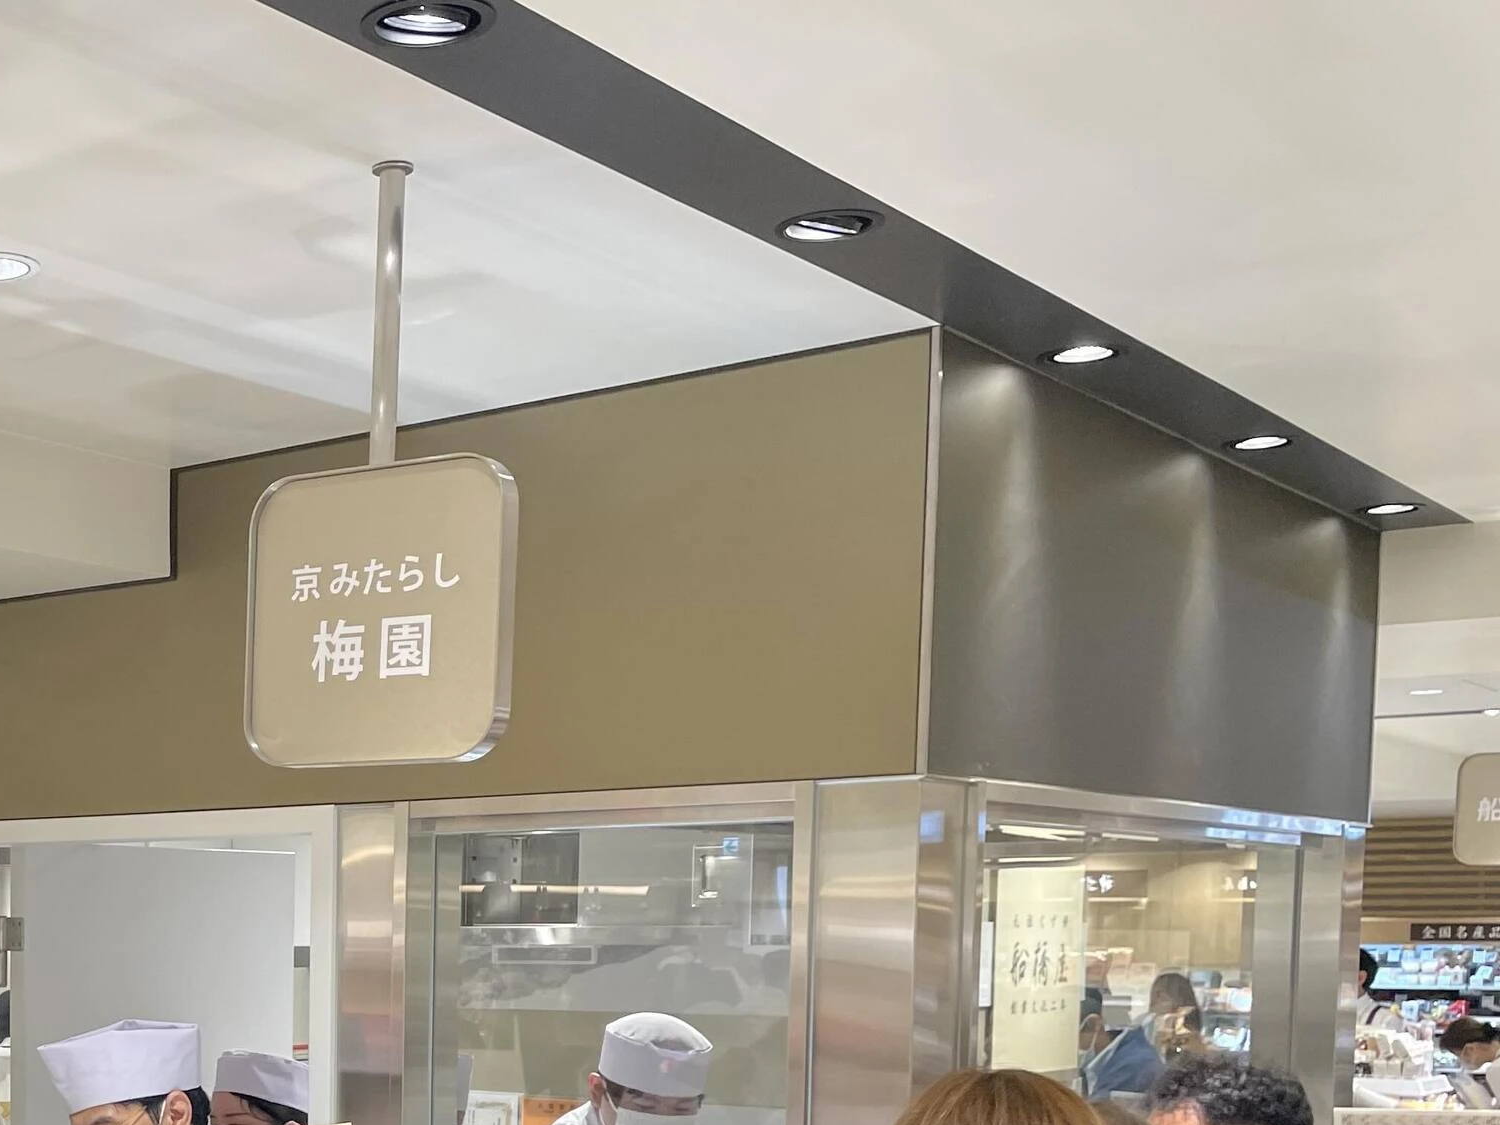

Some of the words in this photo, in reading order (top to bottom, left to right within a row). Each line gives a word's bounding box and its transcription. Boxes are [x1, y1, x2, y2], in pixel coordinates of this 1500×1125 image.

[291, 552, 461, 602] 京みたらし
[311, 614, 433, 683] 梅園
